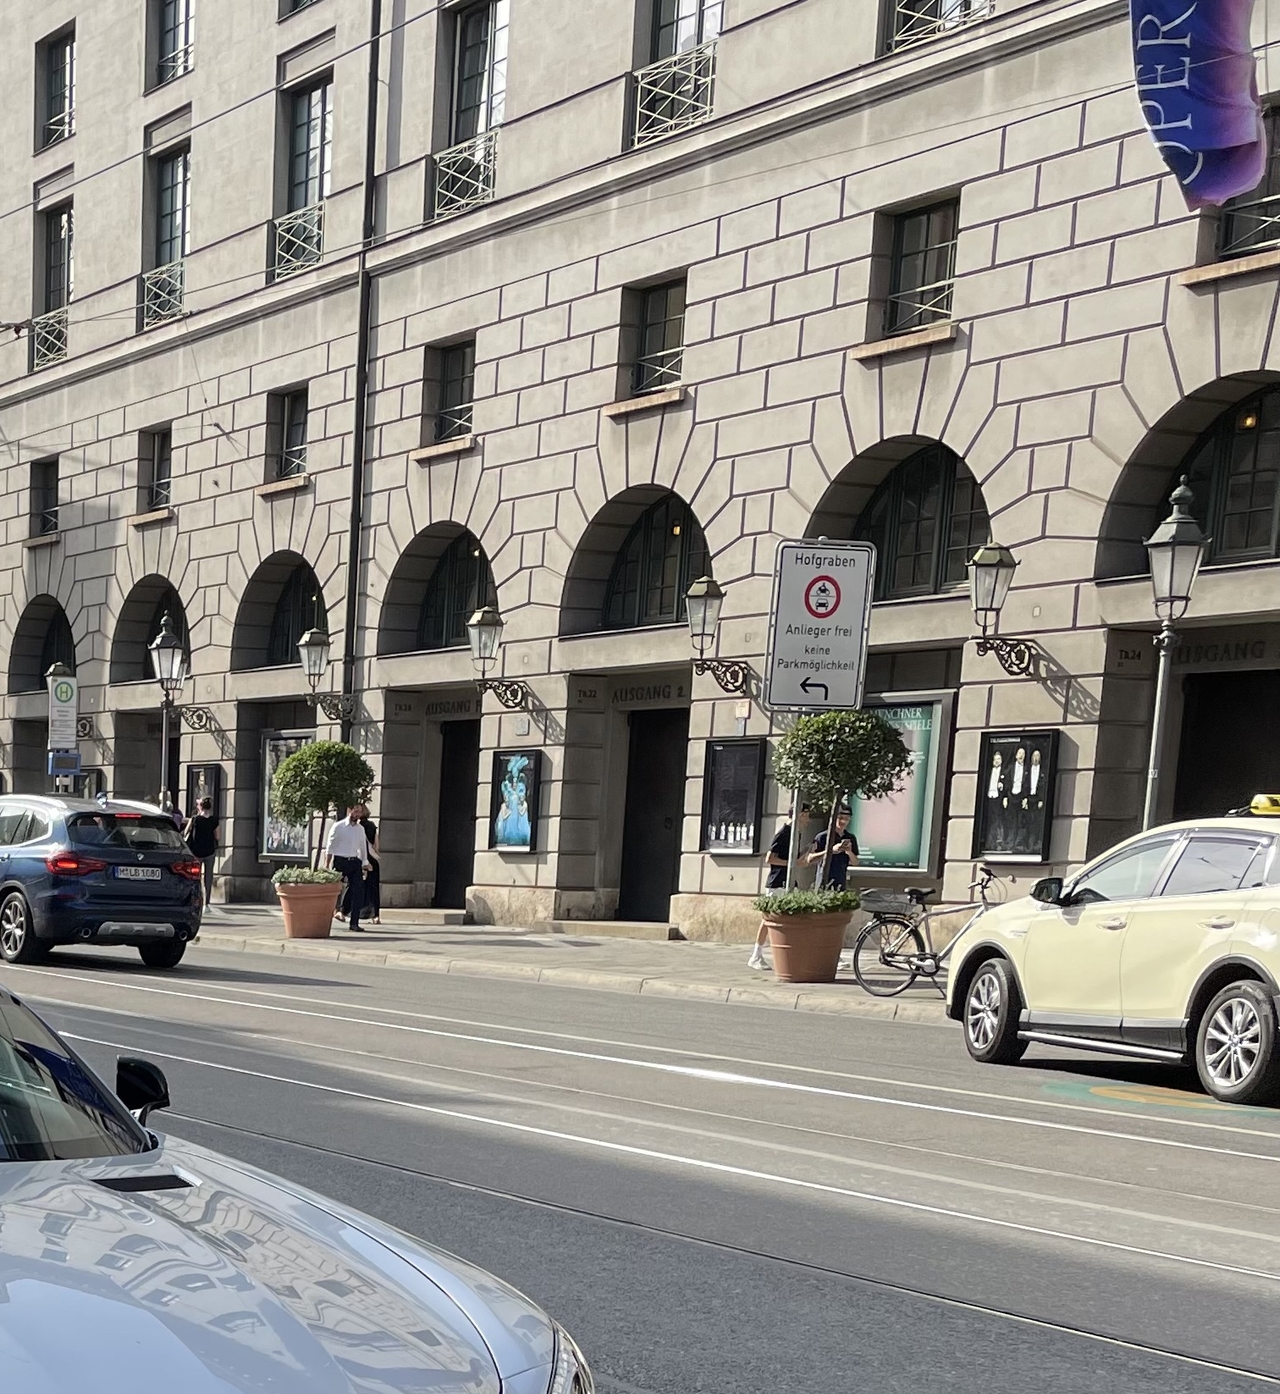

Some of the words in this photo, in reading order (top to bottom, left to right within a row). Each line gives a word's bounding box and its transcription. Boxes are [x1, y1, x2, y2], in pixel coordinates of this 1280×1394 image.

[795, 552, 856, 568] Hofgraben
[785, 623, 832, 638] Anlieger
[834, 624, 852, 637] frei
[804, 644, 831, 655] keine
[777, 658, 855, 672] Parkmöglichkeit
[59, 686, 69, 698] H
[612, 685, 671, 704] AUSGANG
[425, 700, 471, 716] AUSGANG
